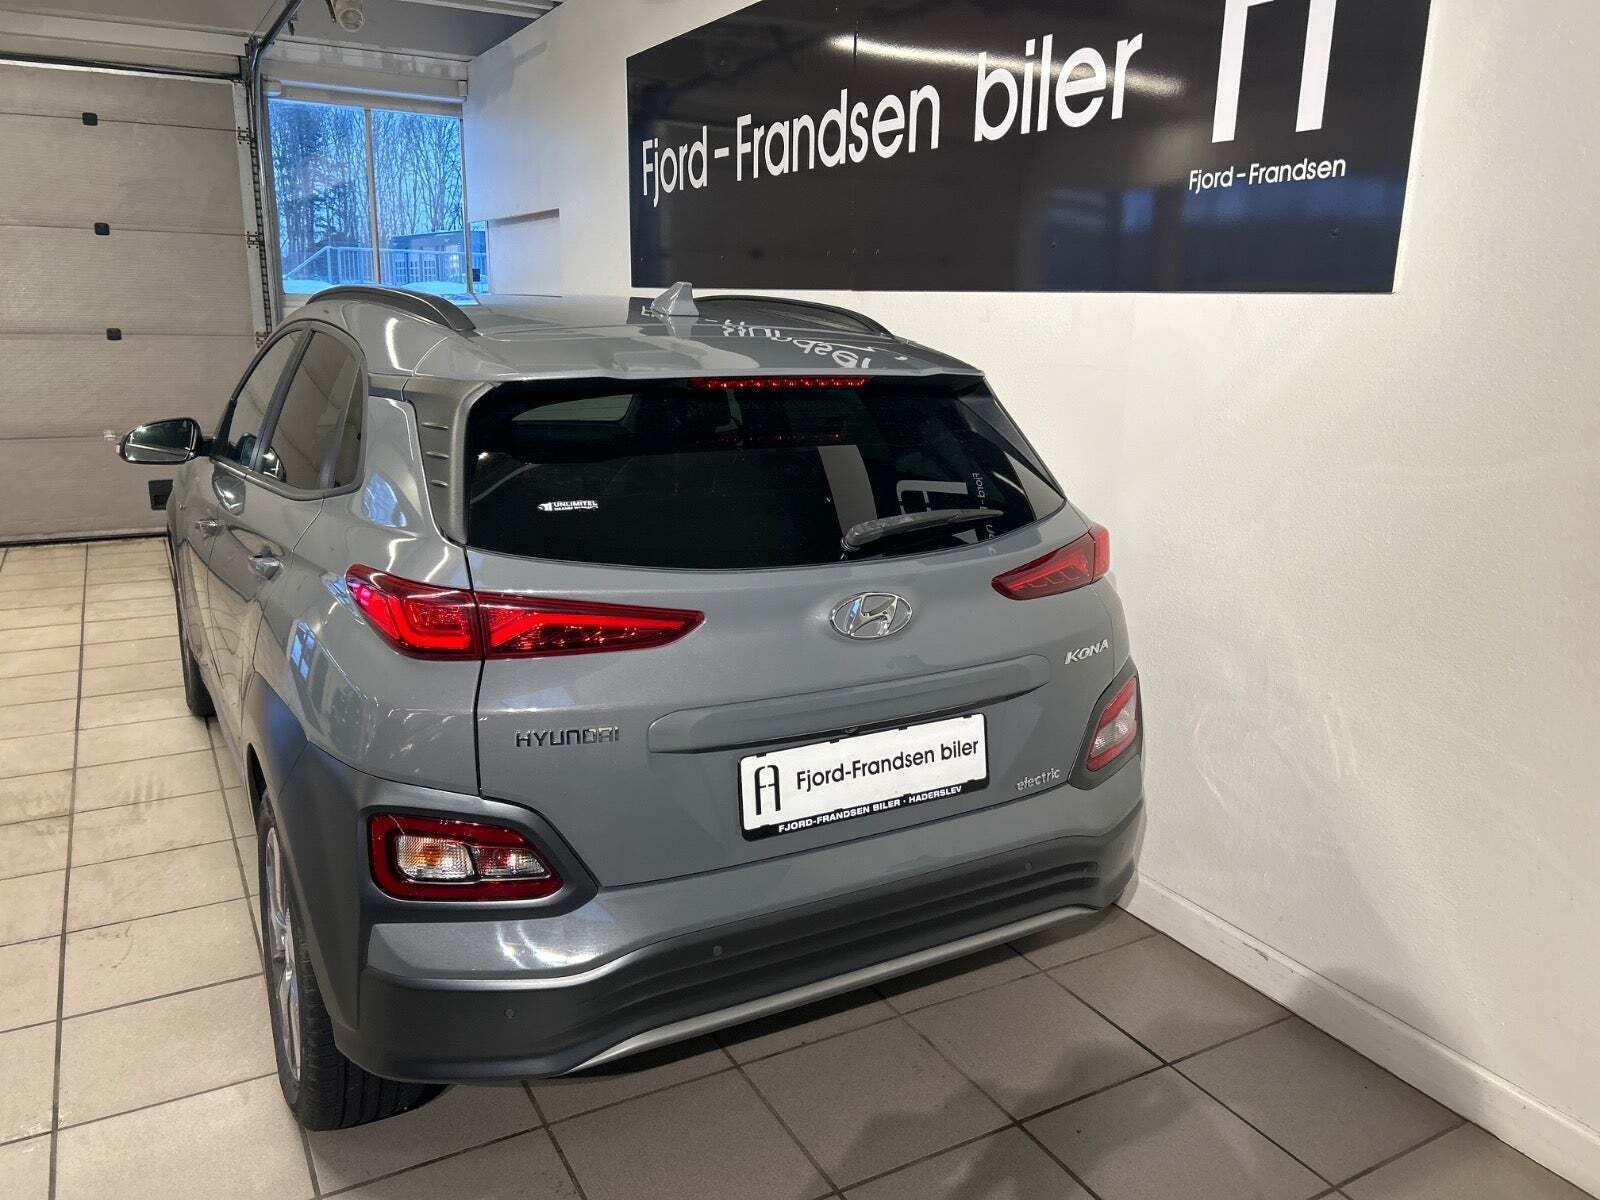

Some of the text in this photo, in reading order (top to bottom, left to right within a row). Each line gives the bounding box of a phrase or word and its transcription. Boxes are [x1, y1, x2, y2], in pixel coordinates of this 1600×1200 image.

[974, 32, 1143, 142] biler
[1064, 638, 1110, 665] KONA
[515, 726, 620, 748] HYUNDAI
[796, 739, 979, 793] Fjord-Frandsen biler
[1016, 767, 1061, 791] electric
[777, 785, 963, 833] FJORD-FRANDSEN BILER HADERSLEV
